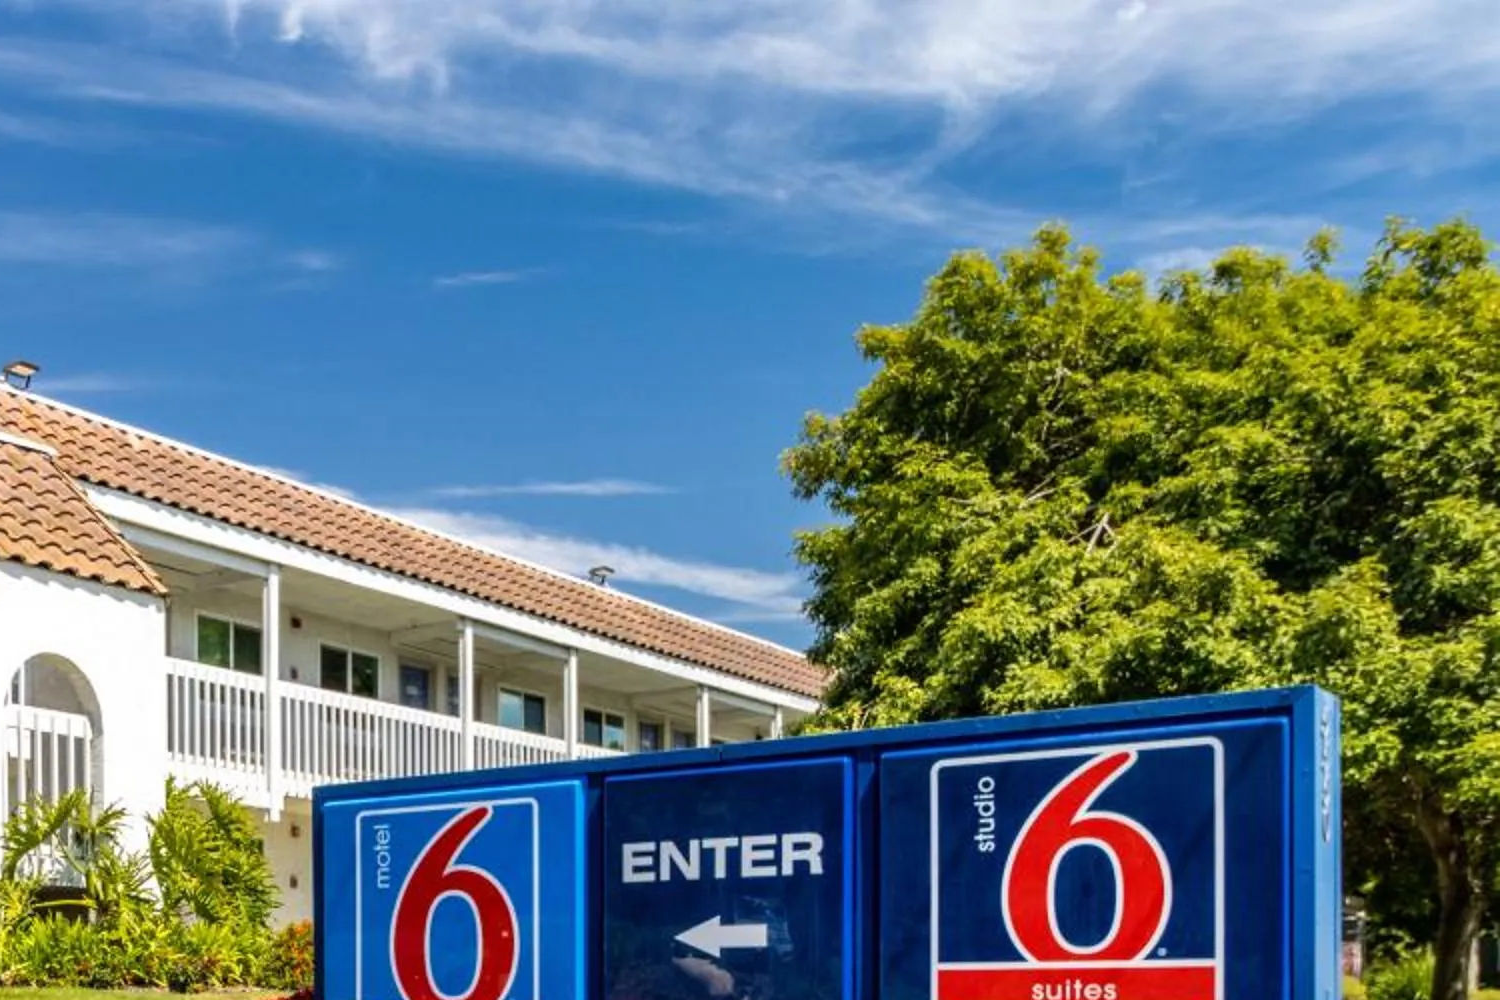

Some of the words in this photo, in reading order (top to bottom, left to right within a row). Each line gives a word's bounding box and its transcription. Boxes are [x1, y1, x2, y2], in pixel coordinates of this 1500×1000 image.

[374, 824, 391, 888] motel
[621, 832, 824, 883] ENTER
[974, 776, 996, 852] studio
[1001, 750, 1172, 962] 6
